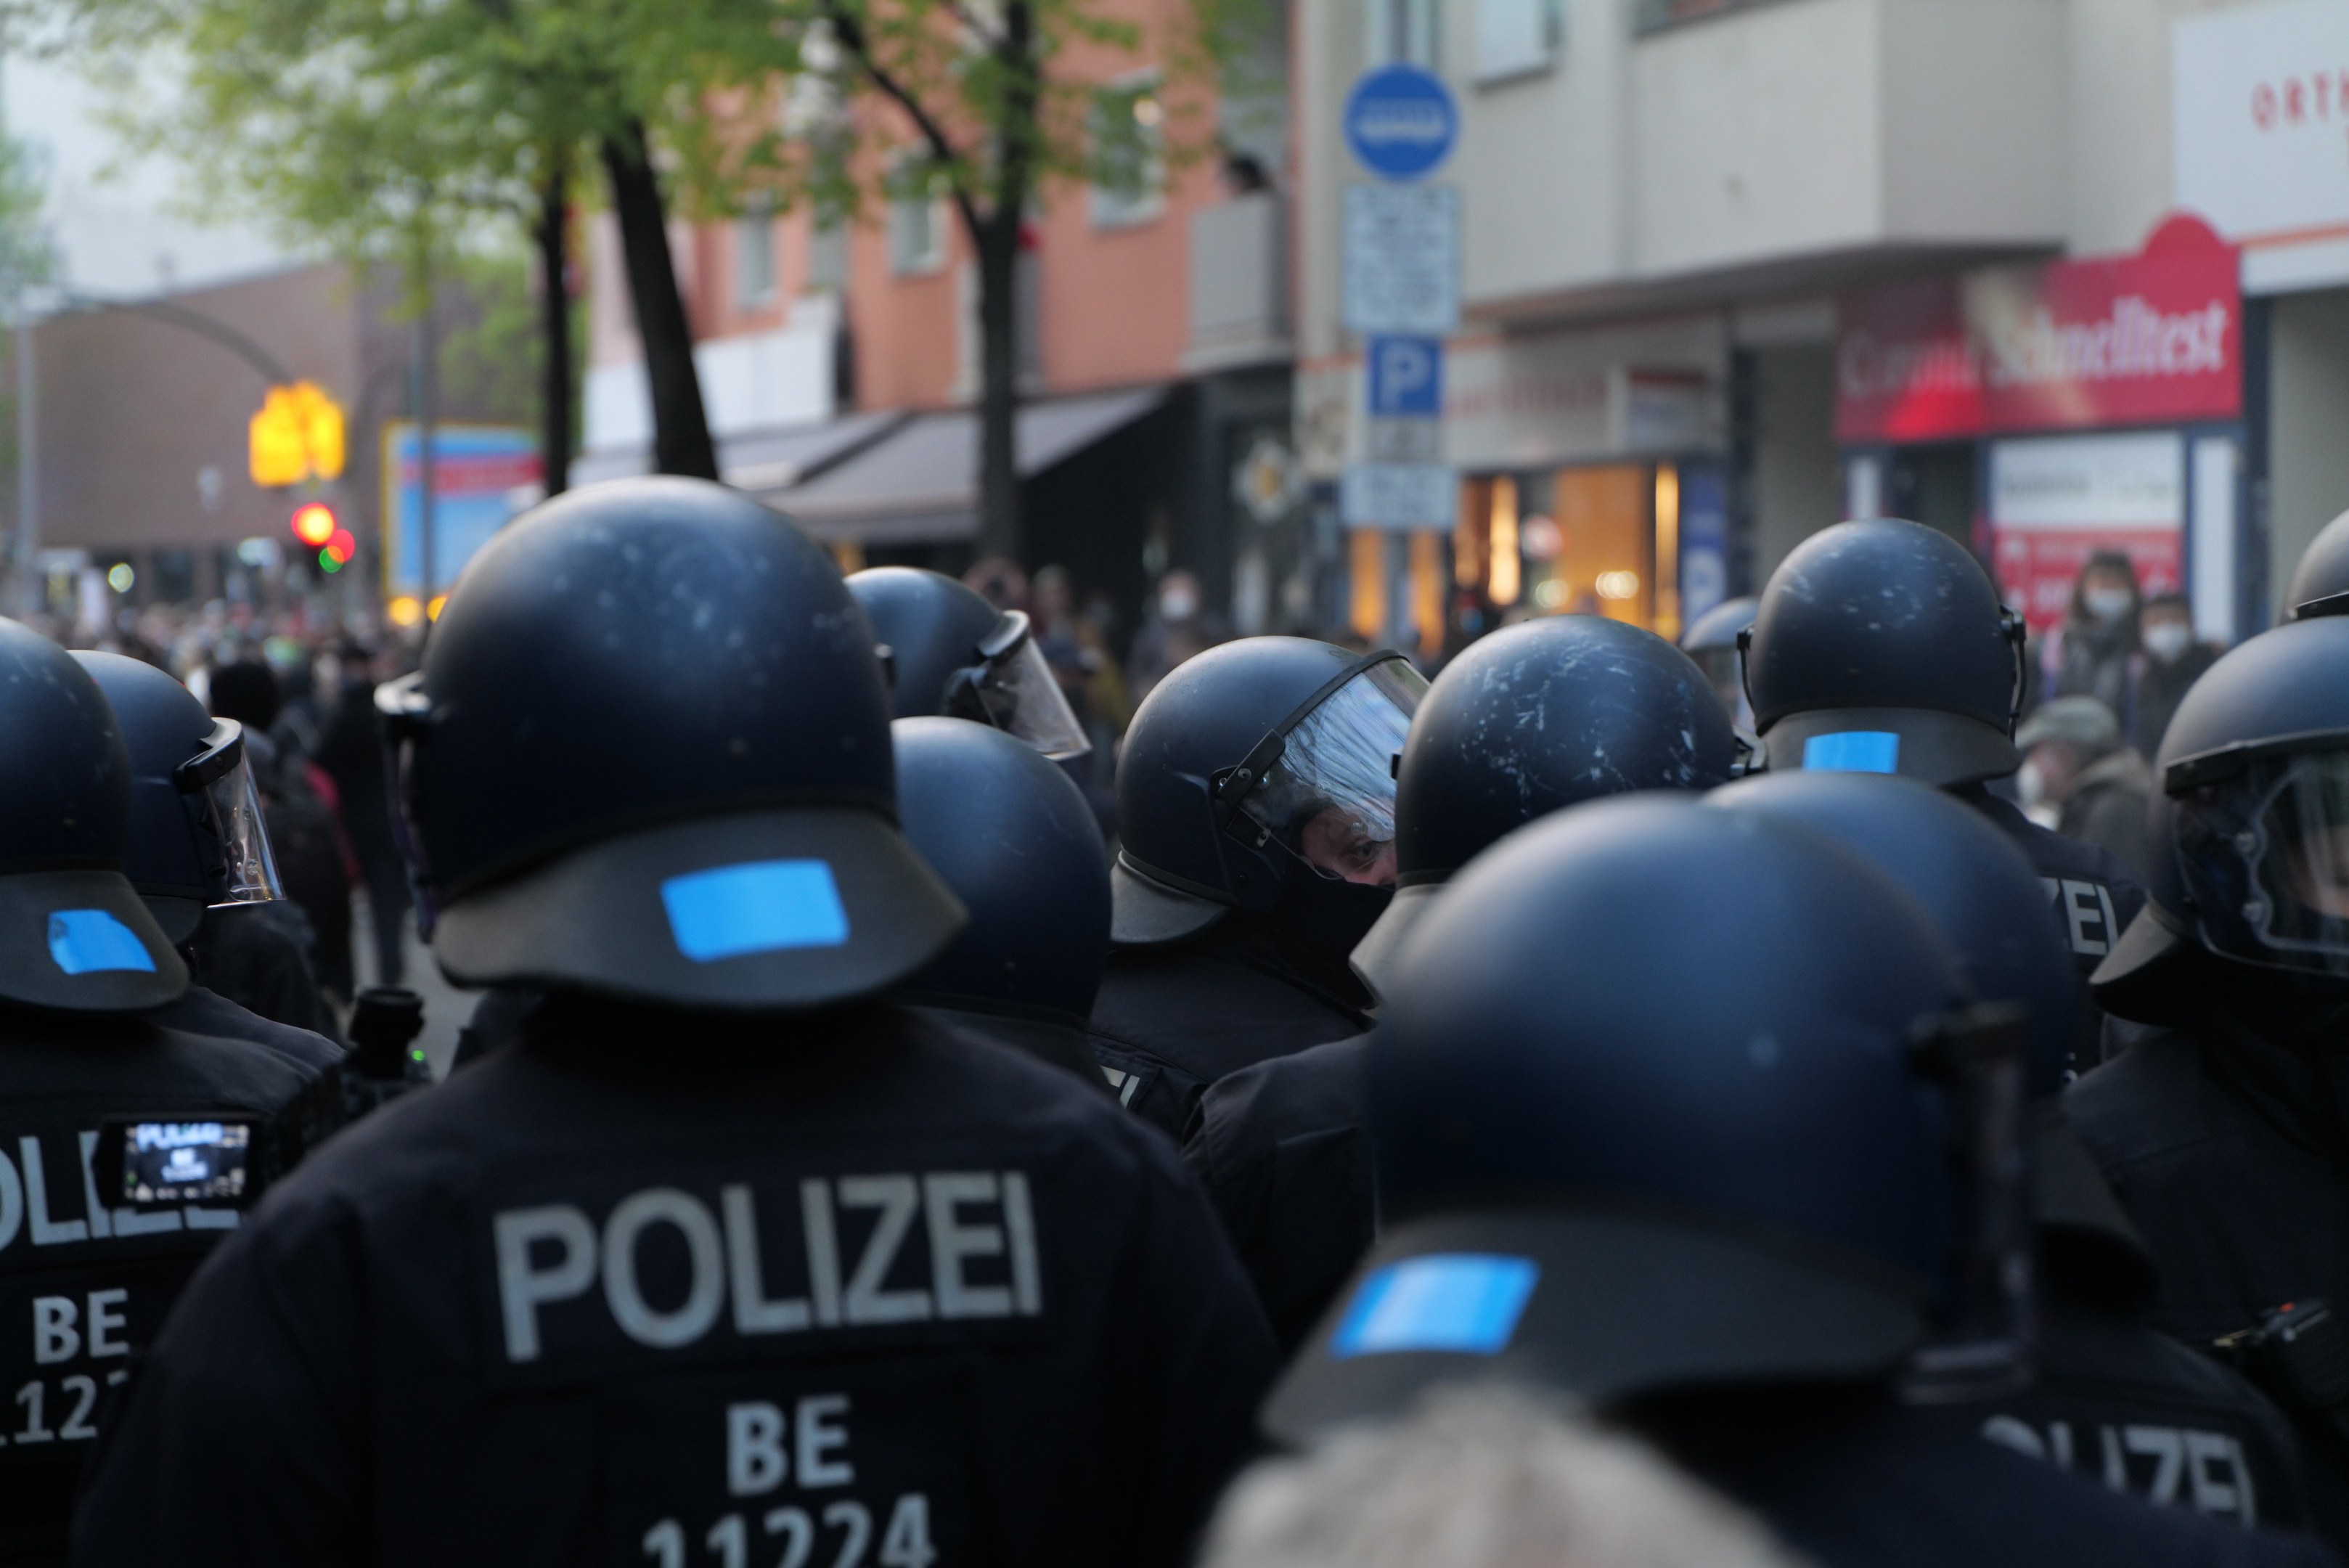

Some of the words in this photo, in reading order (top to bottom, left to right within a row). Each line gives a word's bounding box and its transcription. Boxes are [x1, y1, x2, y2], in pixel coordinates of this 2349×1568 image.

[1379, 341, 1431, 412] P
[494, 1172, 1040, 1361] POLIZEI
[33, 1289, 128, 1363] BE
[727, 1395, 854, 1497] BE
